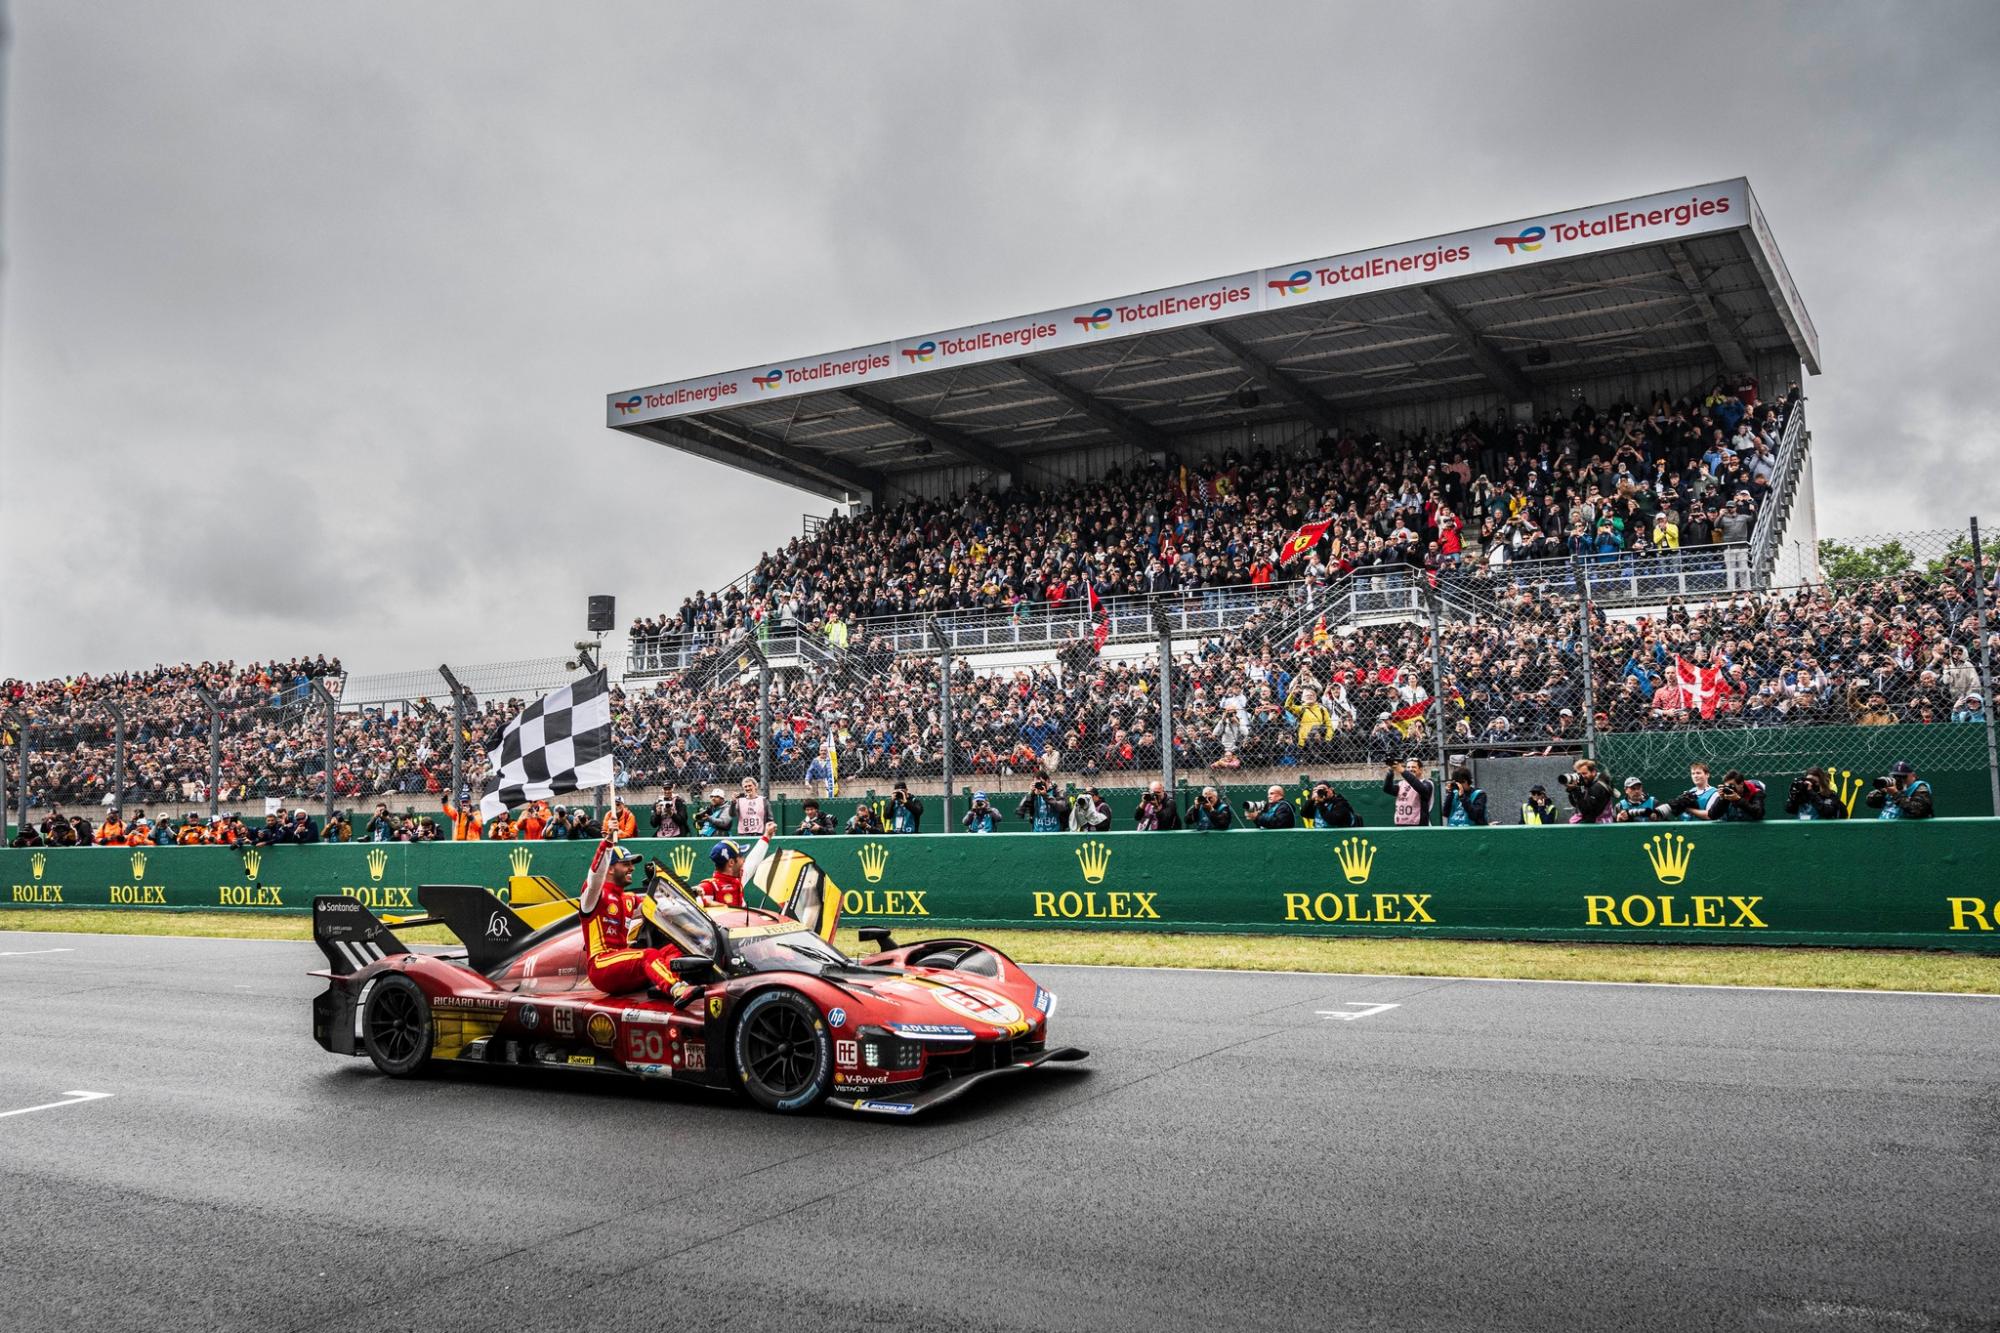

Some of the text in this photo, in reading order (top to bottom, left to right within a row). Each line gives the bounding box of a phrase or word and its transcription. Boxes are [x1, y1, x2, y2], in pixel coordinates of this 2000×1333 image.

[1551, 197, 1730, 242] TotalEnergies
[1316, 245, 1470, 286] TotalEnergies
[1116, 287, 1251, 323] TotalEnergies
[939, 323, 1057, 356] TotalEnergies
[785, 354, 890, 384] TotalEnergies
[644, 382, 738, 408] TotalEnergies
[12, 885, 63, 903] ROLEX
[109, 886, 167, 904] ROLEX
[219, 886, 283, 905] ROLEX
[326, 902, 360, 912] Santander
[840, 889, 930, 915] OLEX
[1033, 891, 1160, 918] ROLEX
[1284, 893, 1436, 924] ROLEX
[1584, 895, 1768, 928] ROLEX
[433, 996, 506, 1009] RICHARD MILLE
[829, 1008, 845, 1027] hp
[901, 1024, 942, 1033] ADLER
[629, 1028, 664, 1060] 50
[845, 1074, 888, 1084] V-Power
